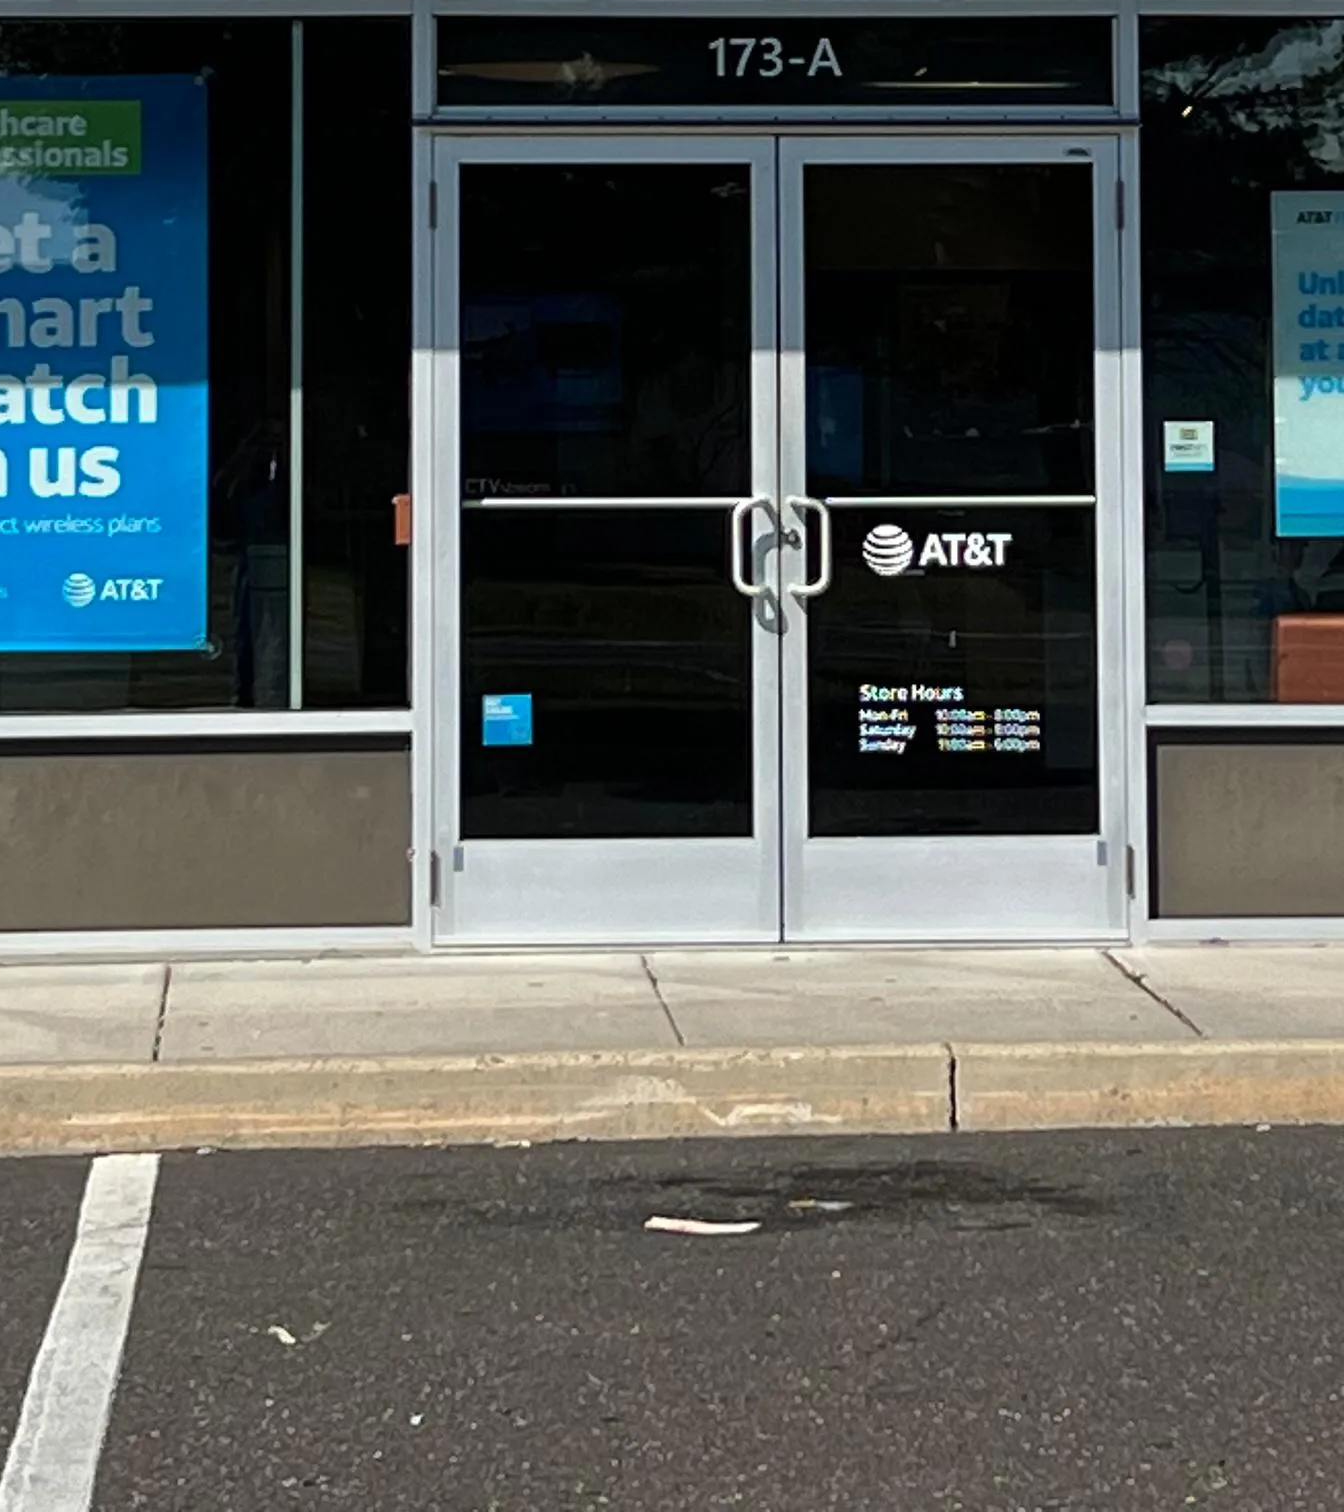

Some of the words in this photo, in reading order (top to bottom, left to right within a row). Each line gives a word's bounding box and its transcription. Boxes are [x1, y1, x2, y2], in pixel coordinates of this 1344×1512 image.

[708, 37, 843, 77] 173-A
[1296, 210, 1333, 225] AT&T
[71, 223, 117, 274] a
[1299, 339, 1329, 362] at
[29, 445, 121, 498] us
[23, 513, 104, 534] wireless
[108, 513, 162, 537] plans
[918, 532, 1013, 568] AT&T
[99, 578, 164, 601] AT&T
[859, 684, 908, 701] Store
[911, 684, 963, 701] Hours
[859, 723, 917, 739] Saturday
[859, 738, 906, 755] Sunday
